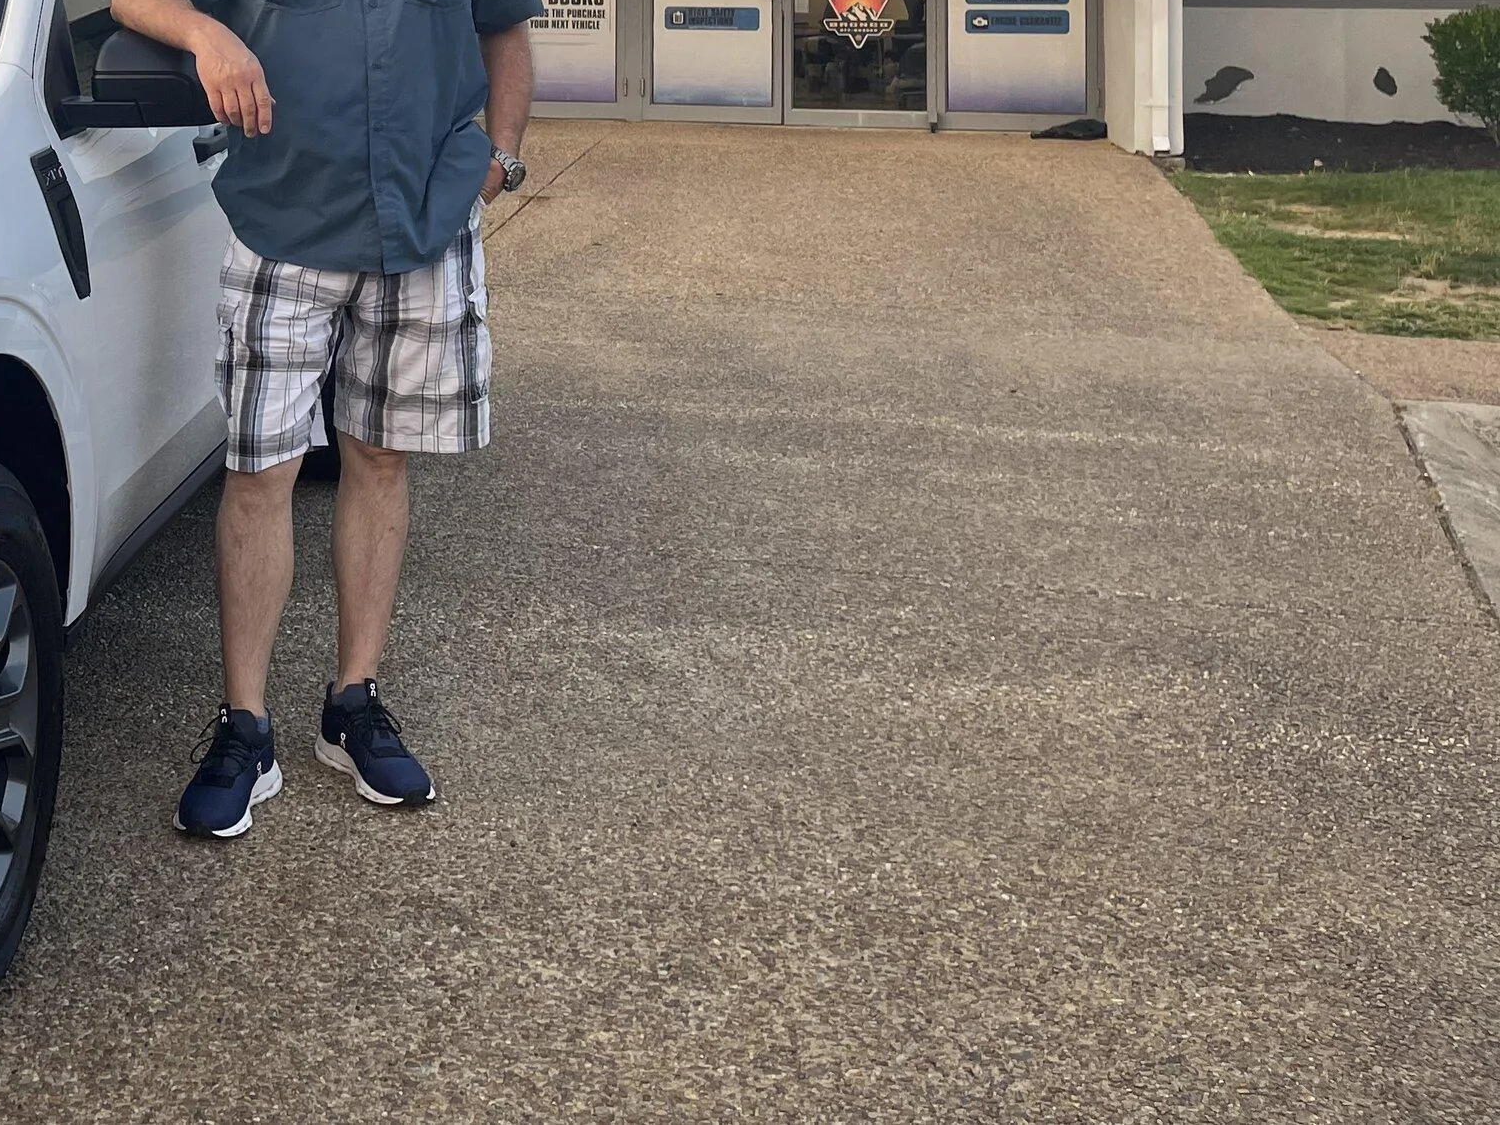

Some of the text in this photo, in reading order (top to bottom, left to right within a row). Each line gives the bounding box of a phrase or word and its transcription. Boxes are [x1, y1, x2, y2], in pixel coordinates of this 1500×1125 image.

[552, 9, 565, 18] THE
[567, 9, 606, 19] PURCHASE
[530, 19, 600, 30] YOUR NEXT VEHICLE
